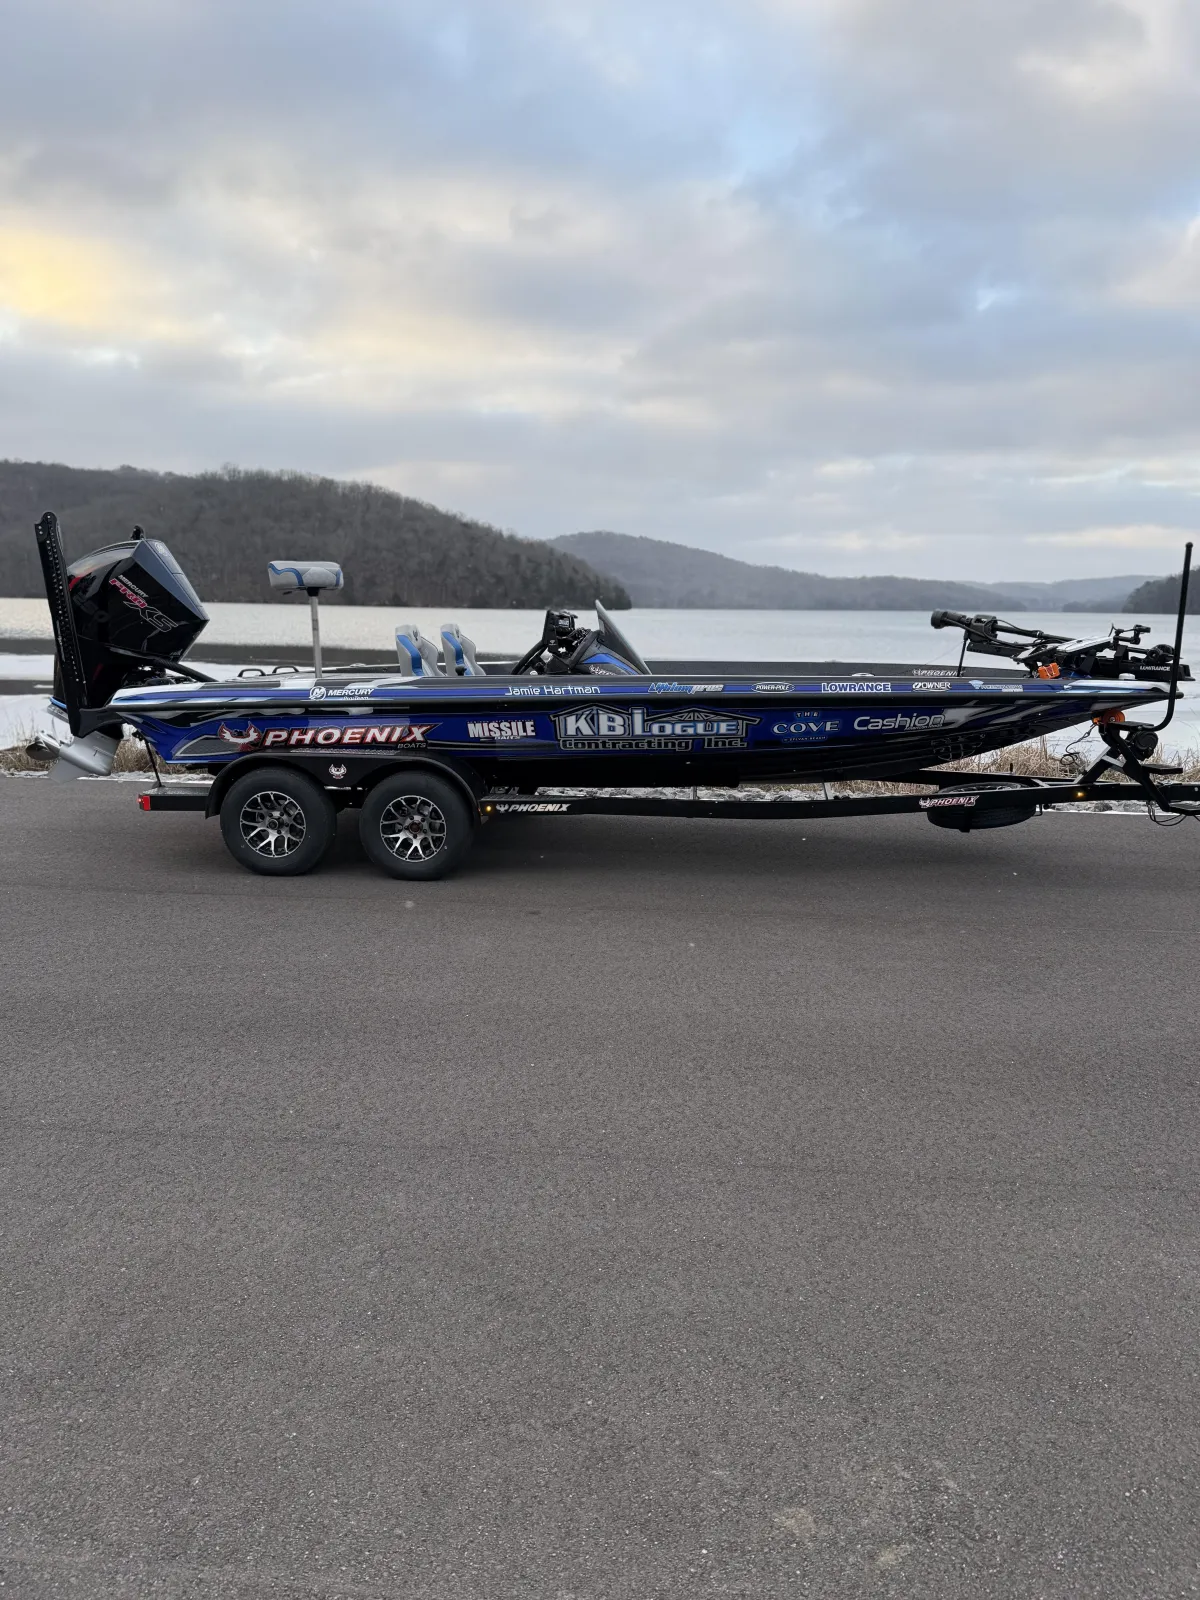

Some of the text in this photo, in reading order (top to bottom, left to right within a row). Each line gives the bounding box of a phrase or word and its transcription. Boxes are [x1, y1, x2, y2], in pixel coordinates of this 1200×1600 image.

[505, 685, 600, 696] Jamie Hartman
[821, 682, 891, 693] LOWRANCE
[921, 681, 951, 689] OWNER
[327, 688, 375, 696] MERCURY
[772, 720, 840, 734] COVE
[853, 713, 946, 731] Cashion
[467, 721, 535, 738] MISSILE
[261, 724, 438, 748] PHOENIX
[560, 737, 748, 751] Contracting Inc.
[930, 795, 979, 806] PHOENIX
[508, 803, 571, 812] PHOENIX
